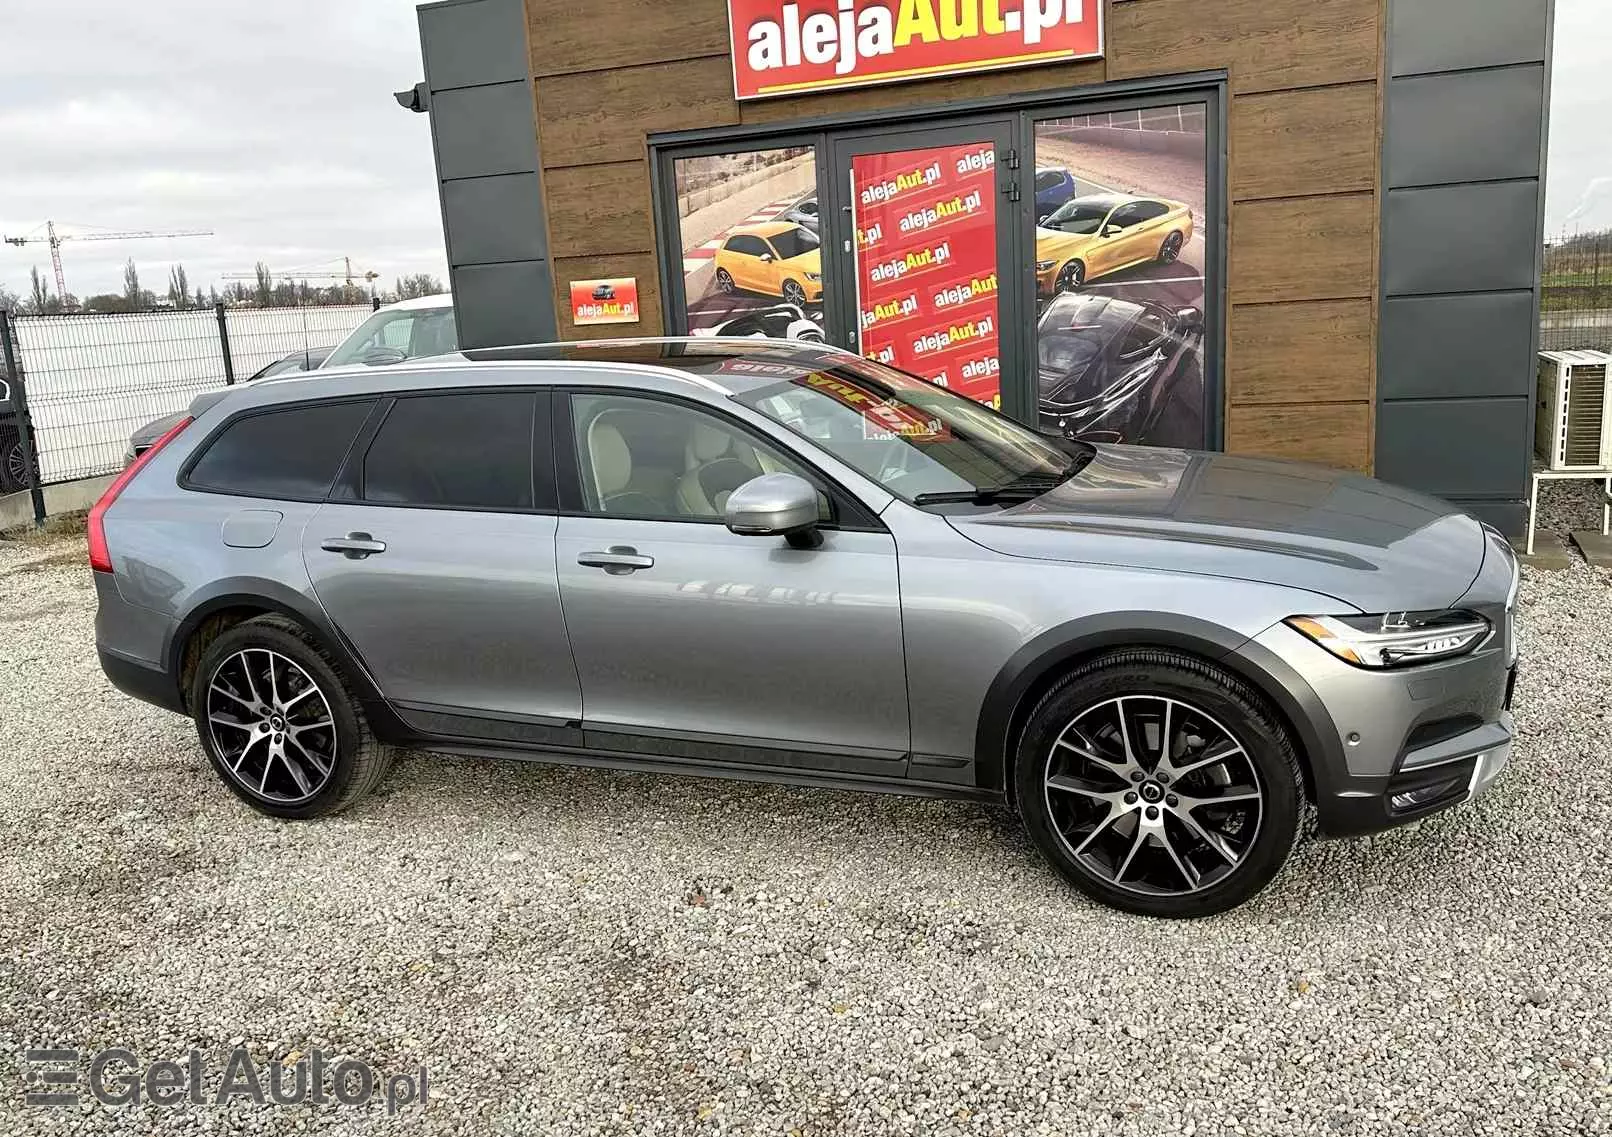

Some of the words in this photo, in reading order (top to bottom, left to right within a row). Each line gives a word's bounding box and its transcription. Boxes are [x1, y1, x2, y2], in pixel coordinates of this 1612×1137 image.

[956, 149, 994, 174] aleja
[861, 162, 942, 204] alejaAut.pl
[899, 190, 981, 232] alejaAut.pl
[871, 242, 951, 282] alejaAut.pl
[577, 302, 635, 317] alejaAut.pl
[913, 316, 994, 354] alejaAut.pl
[961, 356, 1000, 378] aleja
